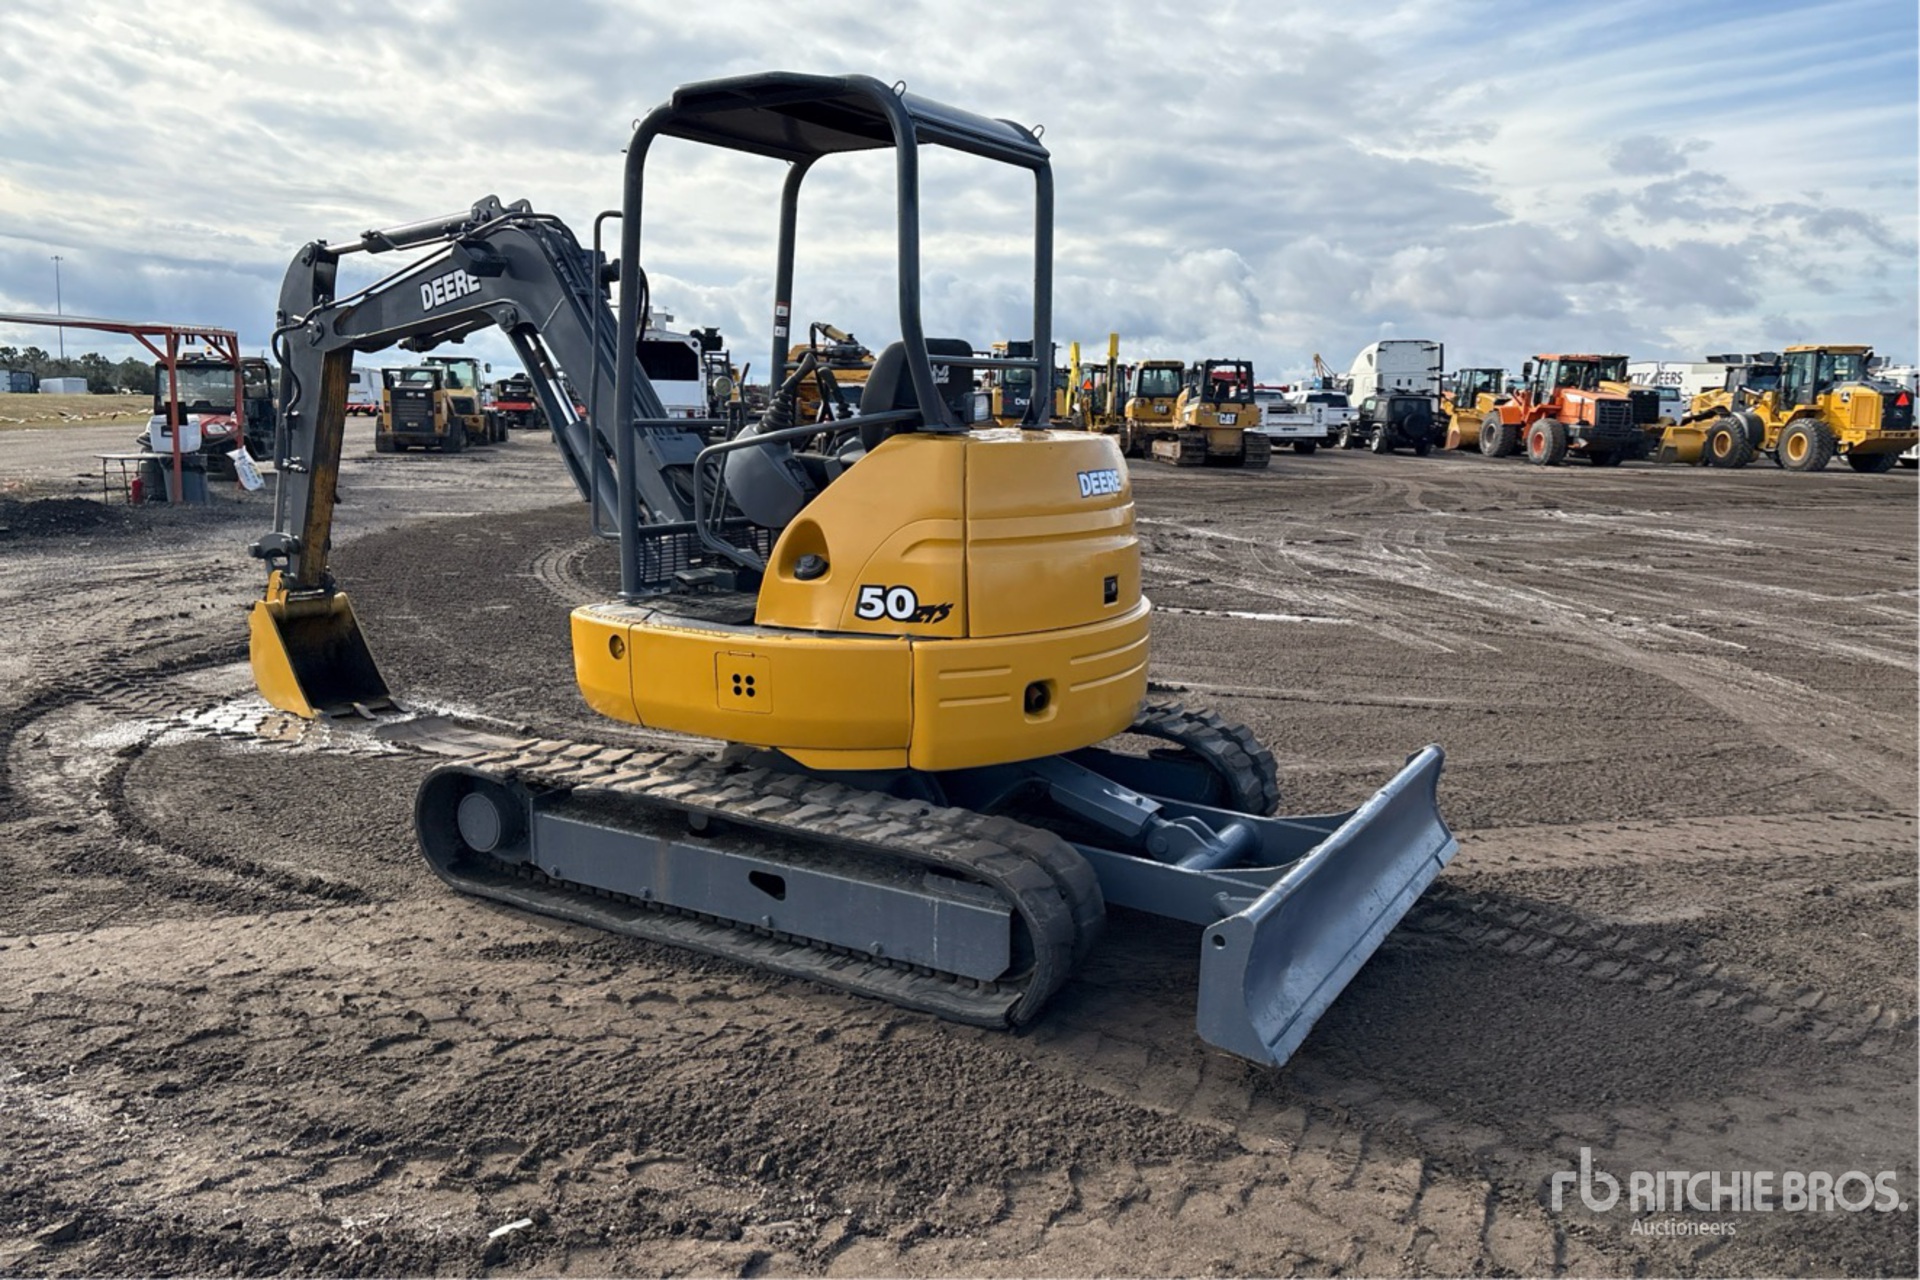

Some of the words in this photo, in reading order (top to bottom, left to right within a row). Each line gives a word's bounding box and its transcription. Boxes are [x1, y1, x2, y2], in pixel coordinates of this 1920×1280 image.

[420, 269, 481, 311] DEERE
[1219, 413, 1236, 425] CAT
[1078, 469, 1122, 497] DEERE
